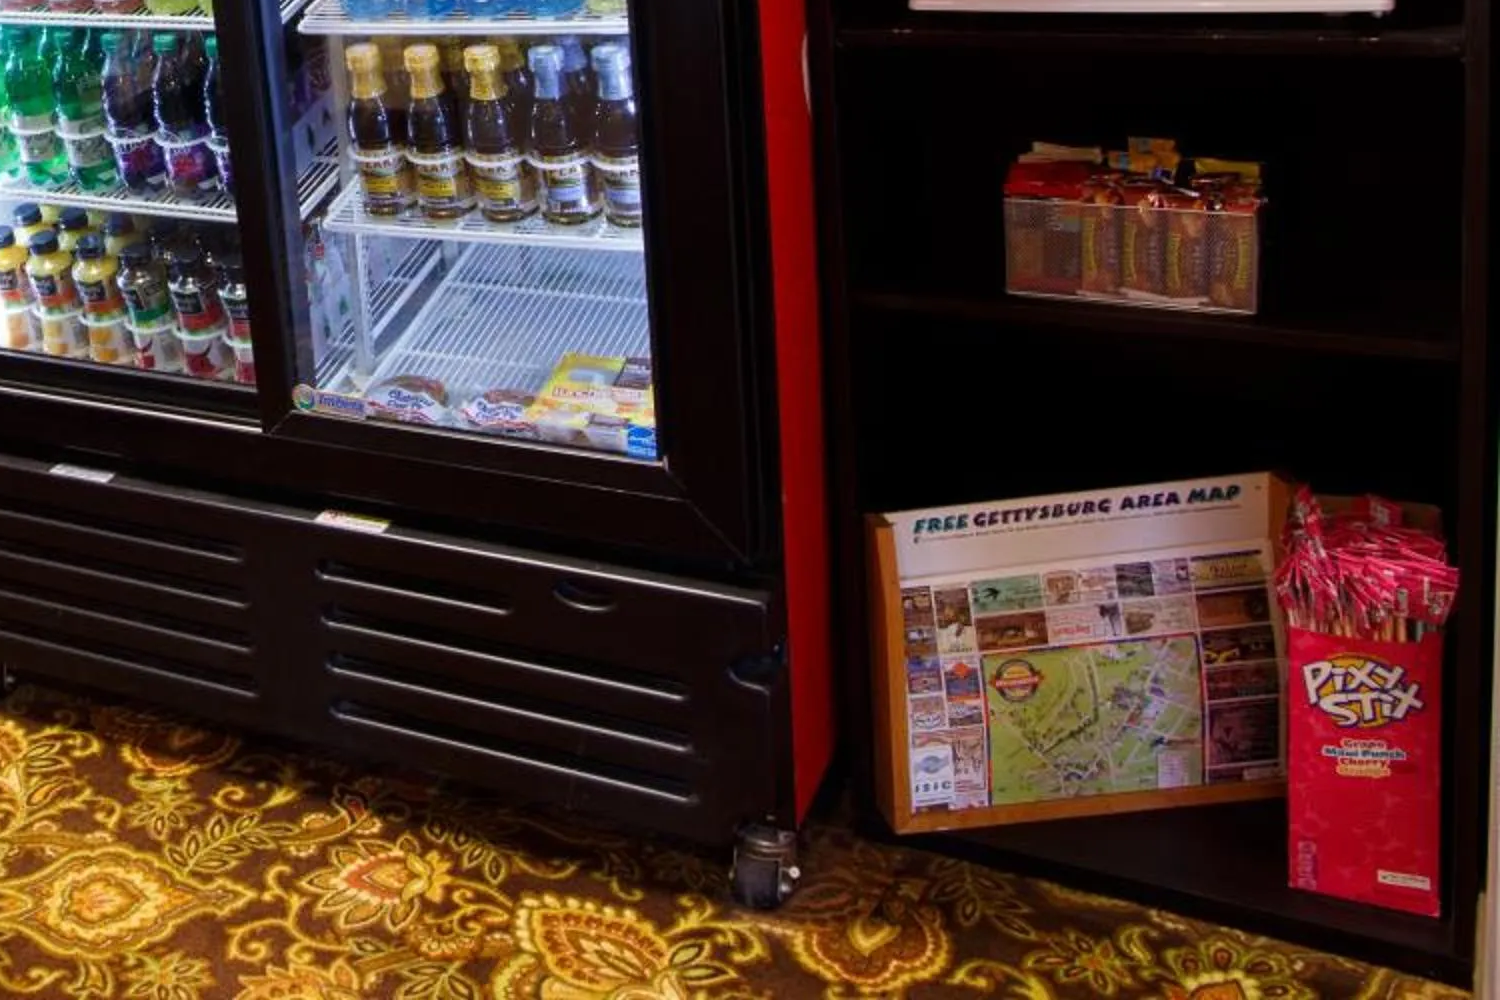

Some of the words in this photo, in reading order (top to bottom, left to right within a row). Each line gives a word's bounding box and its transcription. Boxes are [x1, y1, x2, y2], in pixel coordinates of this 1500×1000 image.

[913, 513, 969, 534] FREE
[973, 498, 1112, 528] GETTYSBURG
[1120, 491, 1181, 511] AREA
[1186, 484, 1242, 504] MAP
[1302, 660, 1405, 705] PIXY
[1318, 684, 1425, 726] STIX
